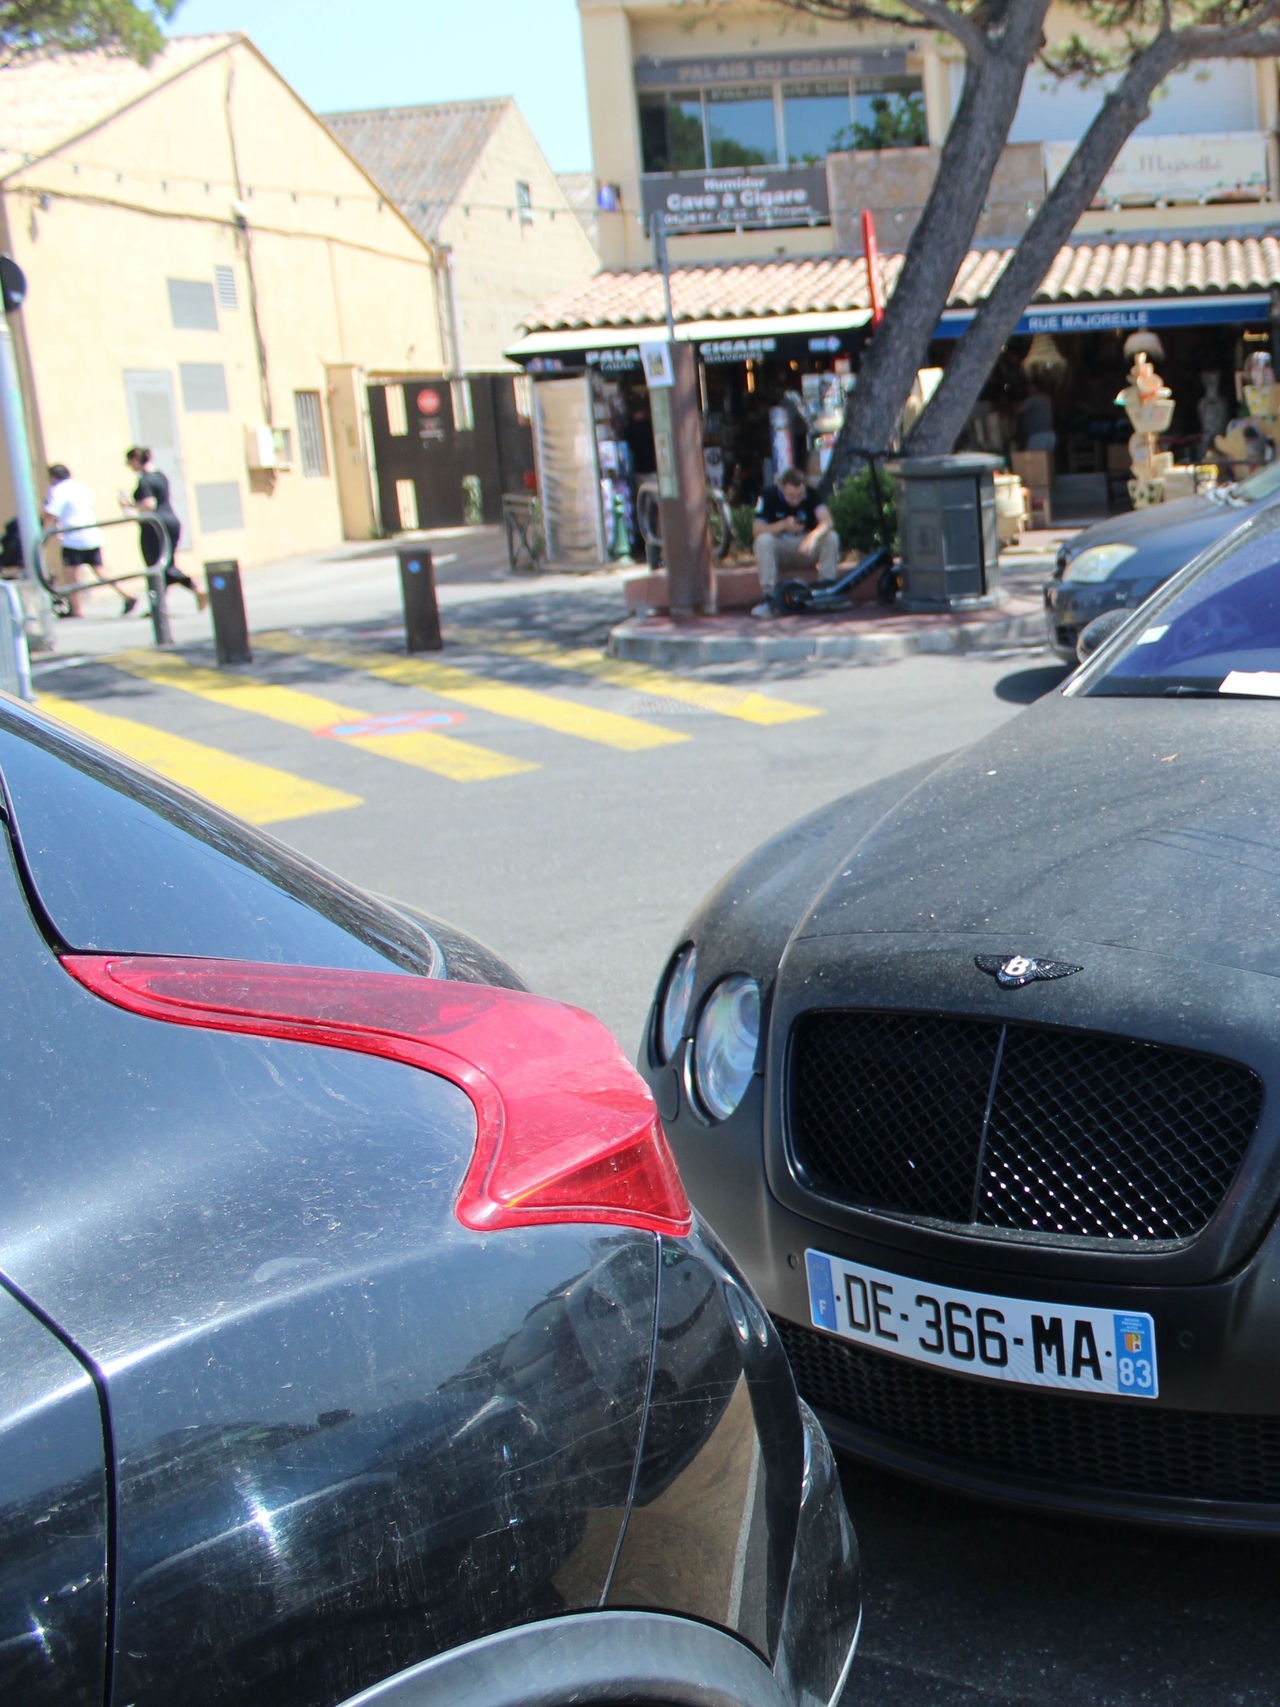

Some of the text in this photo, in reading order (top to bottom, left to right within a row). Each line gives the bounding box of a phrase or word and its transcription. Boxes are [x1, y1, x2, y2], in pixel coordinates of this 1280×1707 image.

[677, 57, 863, 81] PALAIS DU CIGARE
[703, 176, 767, 192] Humidor
[666, 193, 718, 212] Cave
[739, 187, 808, 210] Cigare
[1028, 311, 1148, 331] RUE MAJORELLE
[699, 338, 776, 355] CIGARE
[819, 1299, 826, 1315] F
[843, 1273, 1103, 1381] DE-366-MA
[1118, 1357, 1153, 1389] 83
